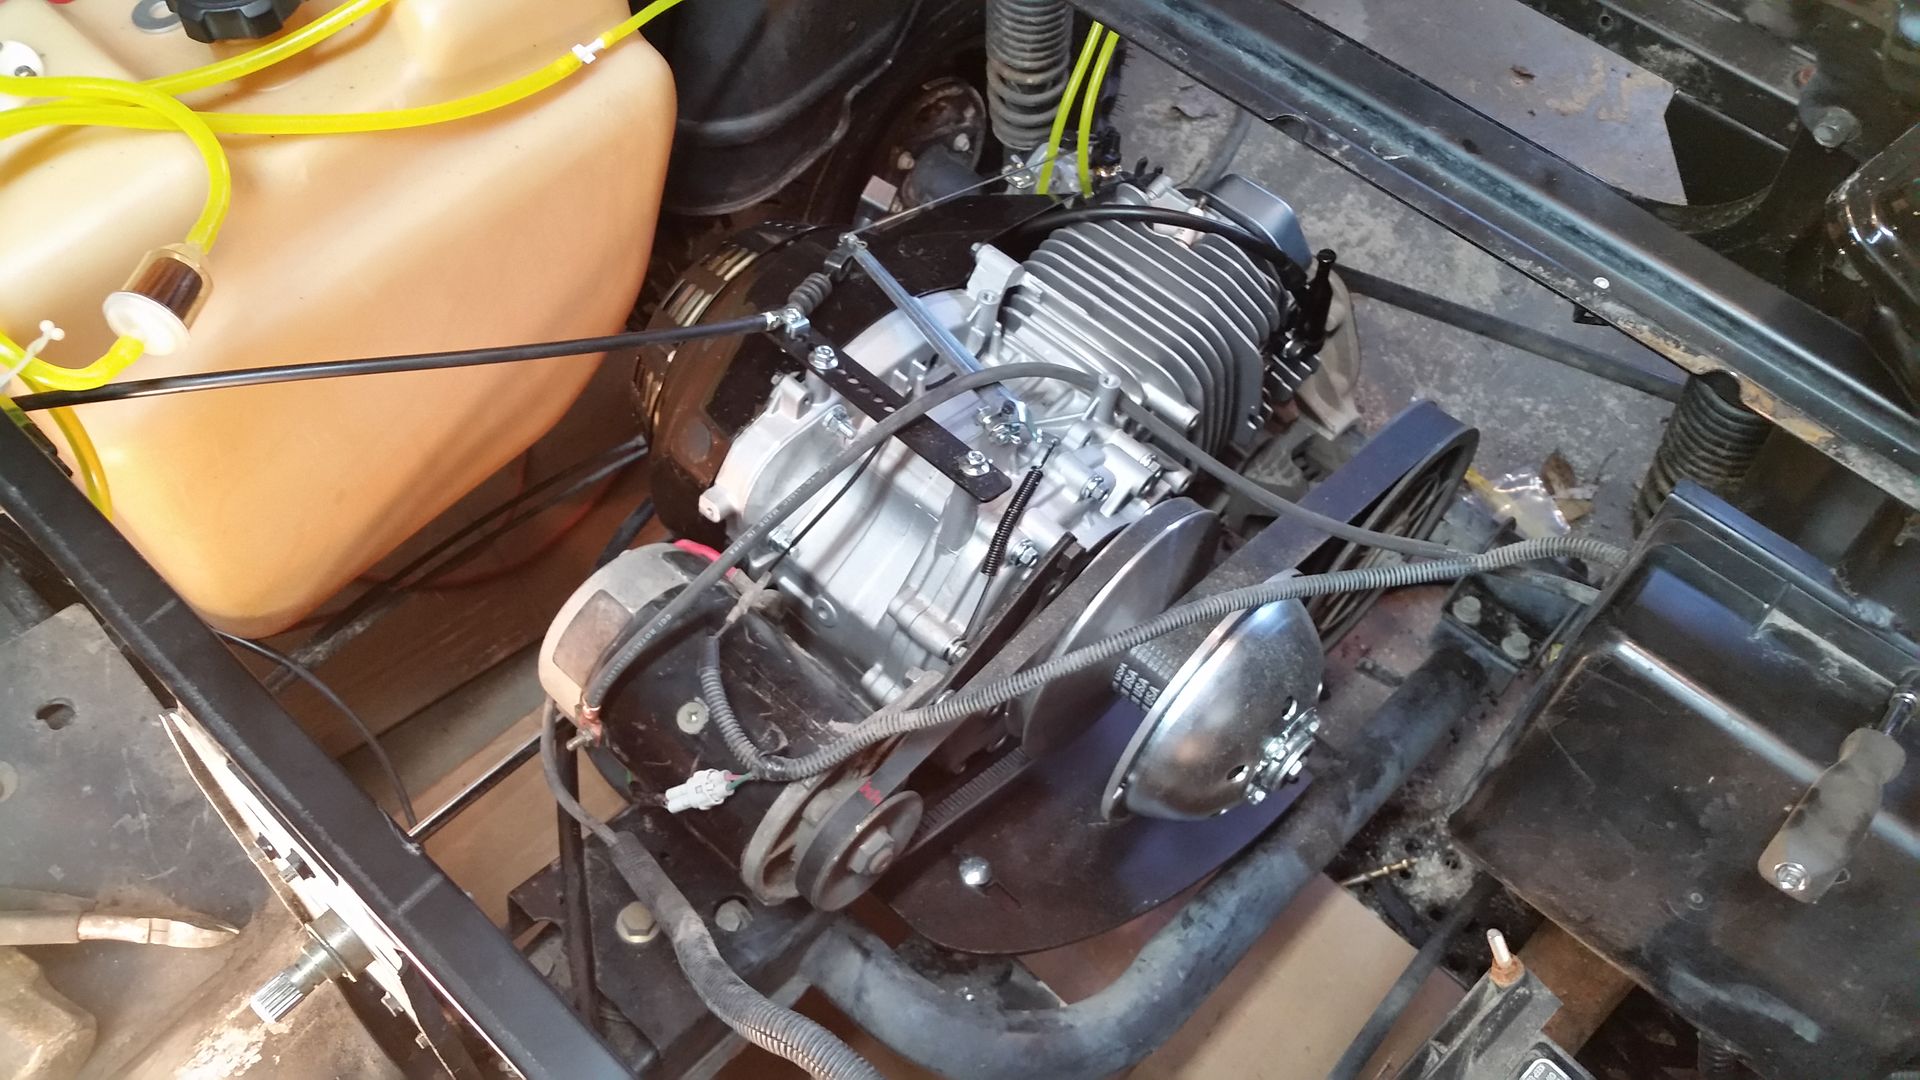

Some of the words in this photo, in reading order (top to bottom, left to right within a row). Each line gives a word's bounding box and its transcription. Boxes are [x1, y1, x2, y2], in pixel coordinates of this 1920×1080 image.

[1114, 662, 1128, 681] USA
[1122, 669, 1139, 689] USA
[1132, 677, 1149, 698] USA
[1143, 686, 1160, 706] USA
